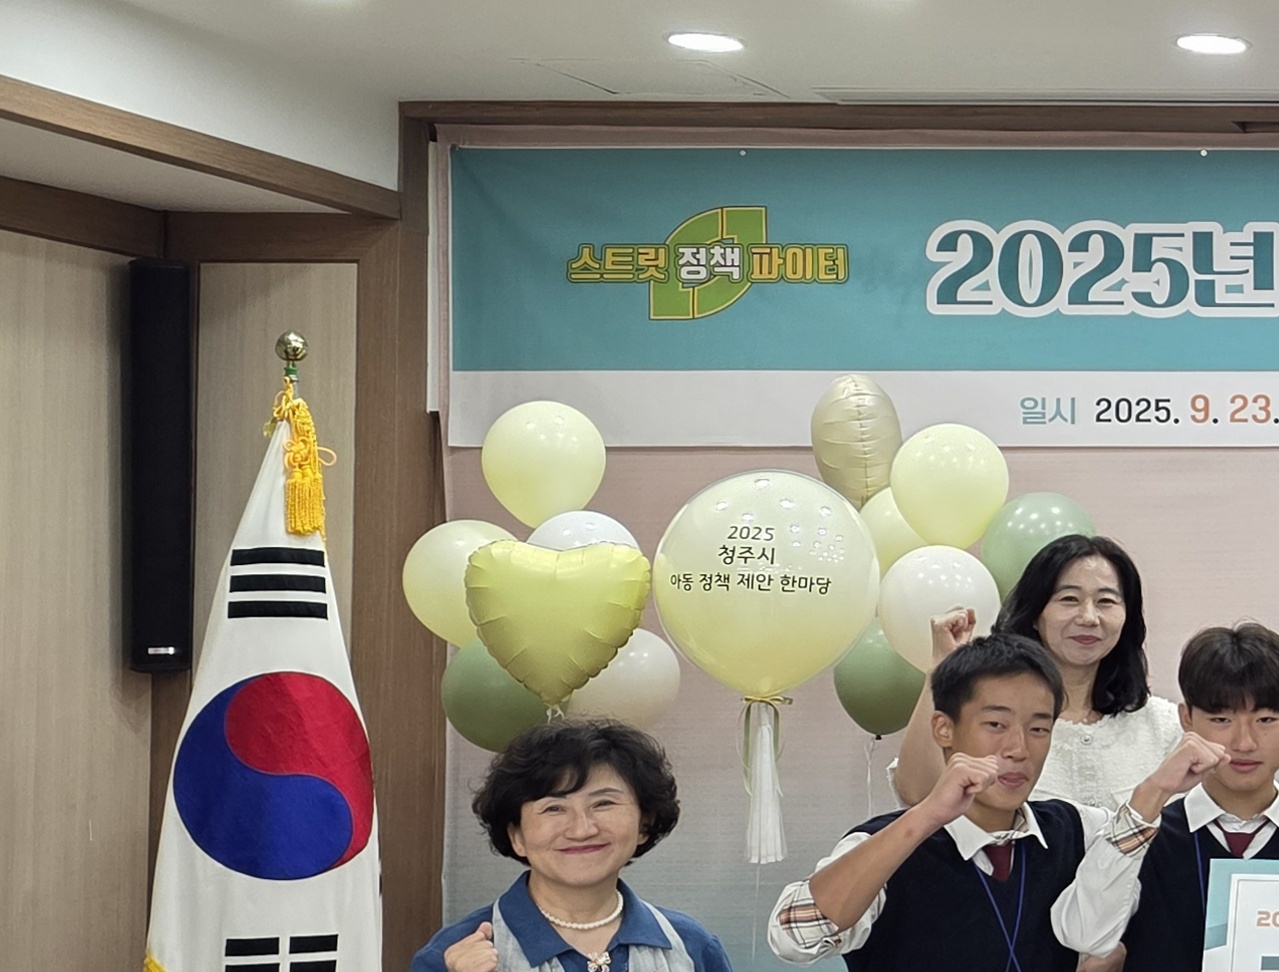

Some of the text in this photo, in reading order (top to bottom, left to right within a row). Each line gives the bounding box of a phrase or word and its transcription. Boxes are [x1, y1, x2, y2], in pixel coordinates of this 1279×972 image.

[568, 244, 848, 282] 스트릿 정책 파이터
[1019, 397, 1076, 425] 일시
[1095, 397, 1180, 425] 2025.
[1190, 393, 1220, 425] 9.
[727, 526, 775, 541] 2025
[718, 545, 775, 565] 청주시
[670, 573, 831, 595] 아동 정책 제안 한마당
